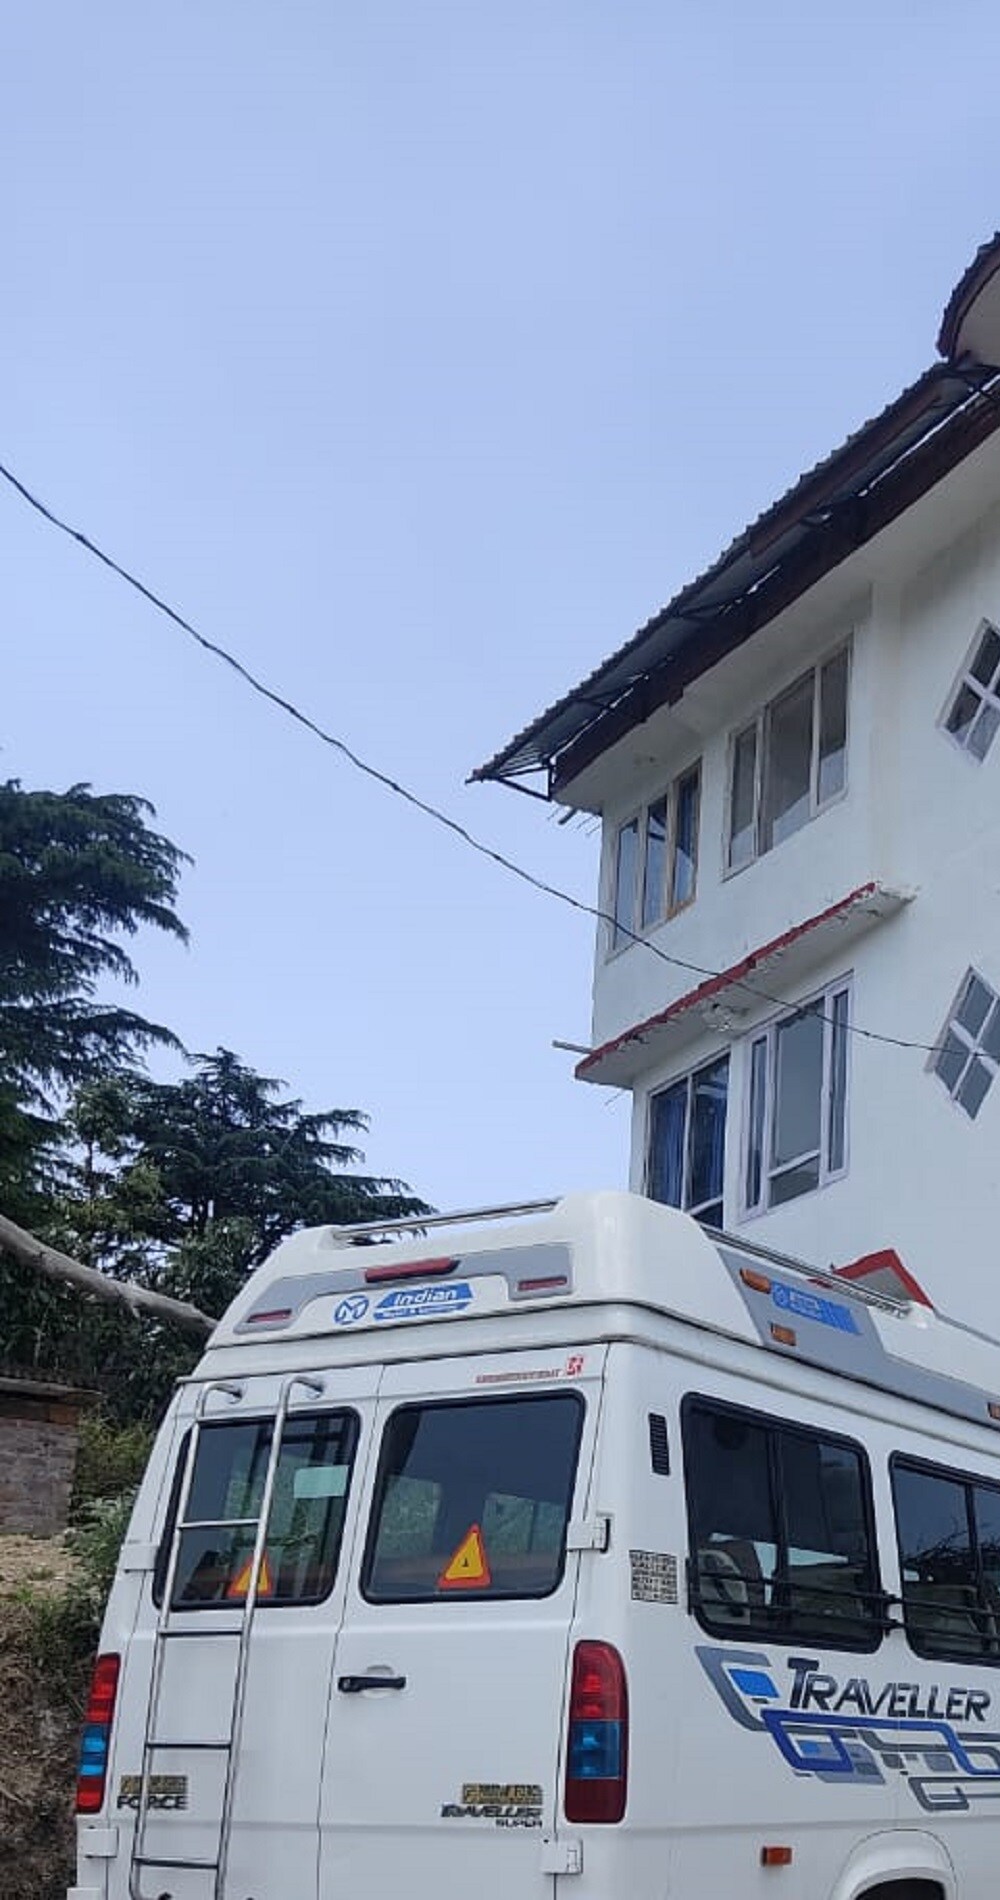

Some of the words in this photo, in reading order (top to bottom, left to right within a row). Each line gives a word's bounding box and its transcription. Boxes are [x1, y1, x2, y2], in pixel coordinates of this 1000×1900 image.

[394, 1289, 458, 1306] Indian
[788, 1657, 991, 1721] TRAVELLER
[496, 1819, 542, 1828] SUPER
